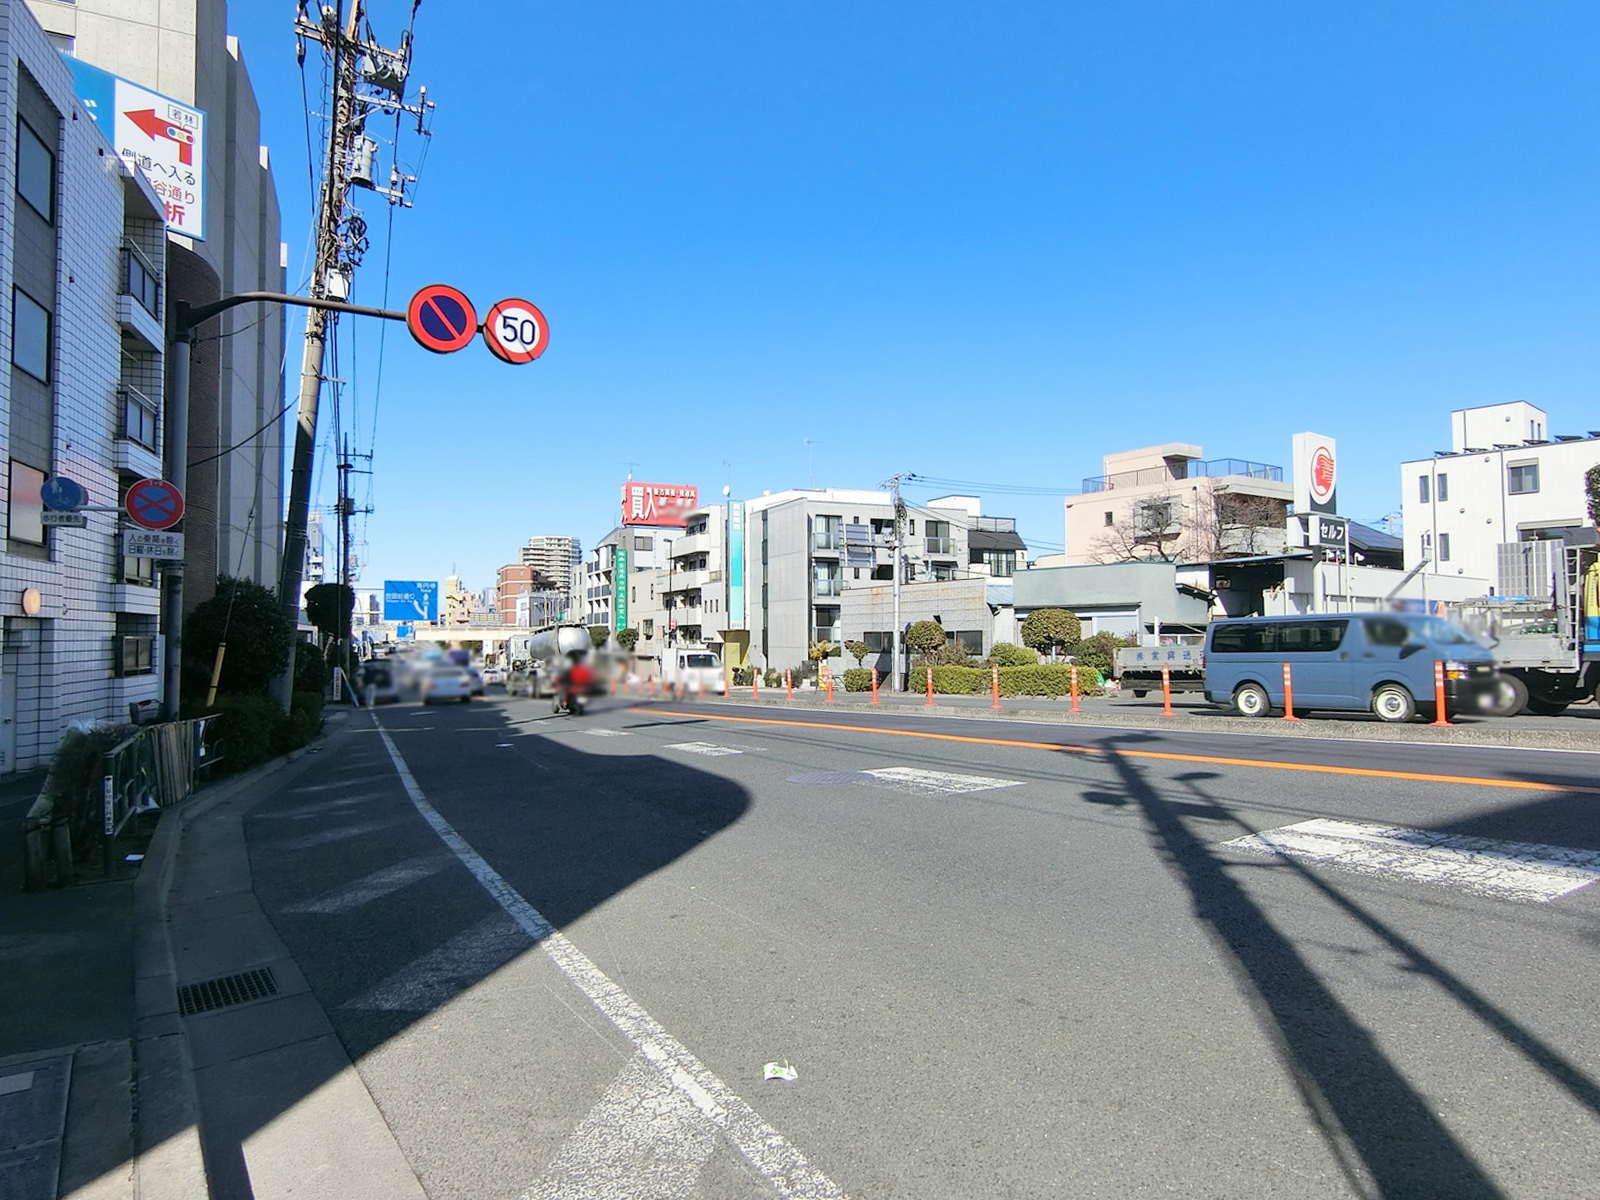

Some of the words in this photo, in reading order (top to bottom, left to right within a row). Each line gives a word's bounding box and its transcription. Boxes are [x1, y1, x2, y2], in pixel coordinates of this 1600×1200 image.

[173, 109, 194, 124] 若林
[146, 177, 195, 204] 谷通り
[503, 315, 536, 345] 50
[43, 514, 81, 523] 歩行者優先
[128, 533, 180, 545] 人の乗降を除く
[1320, 522, 1344, 540] セルフ
